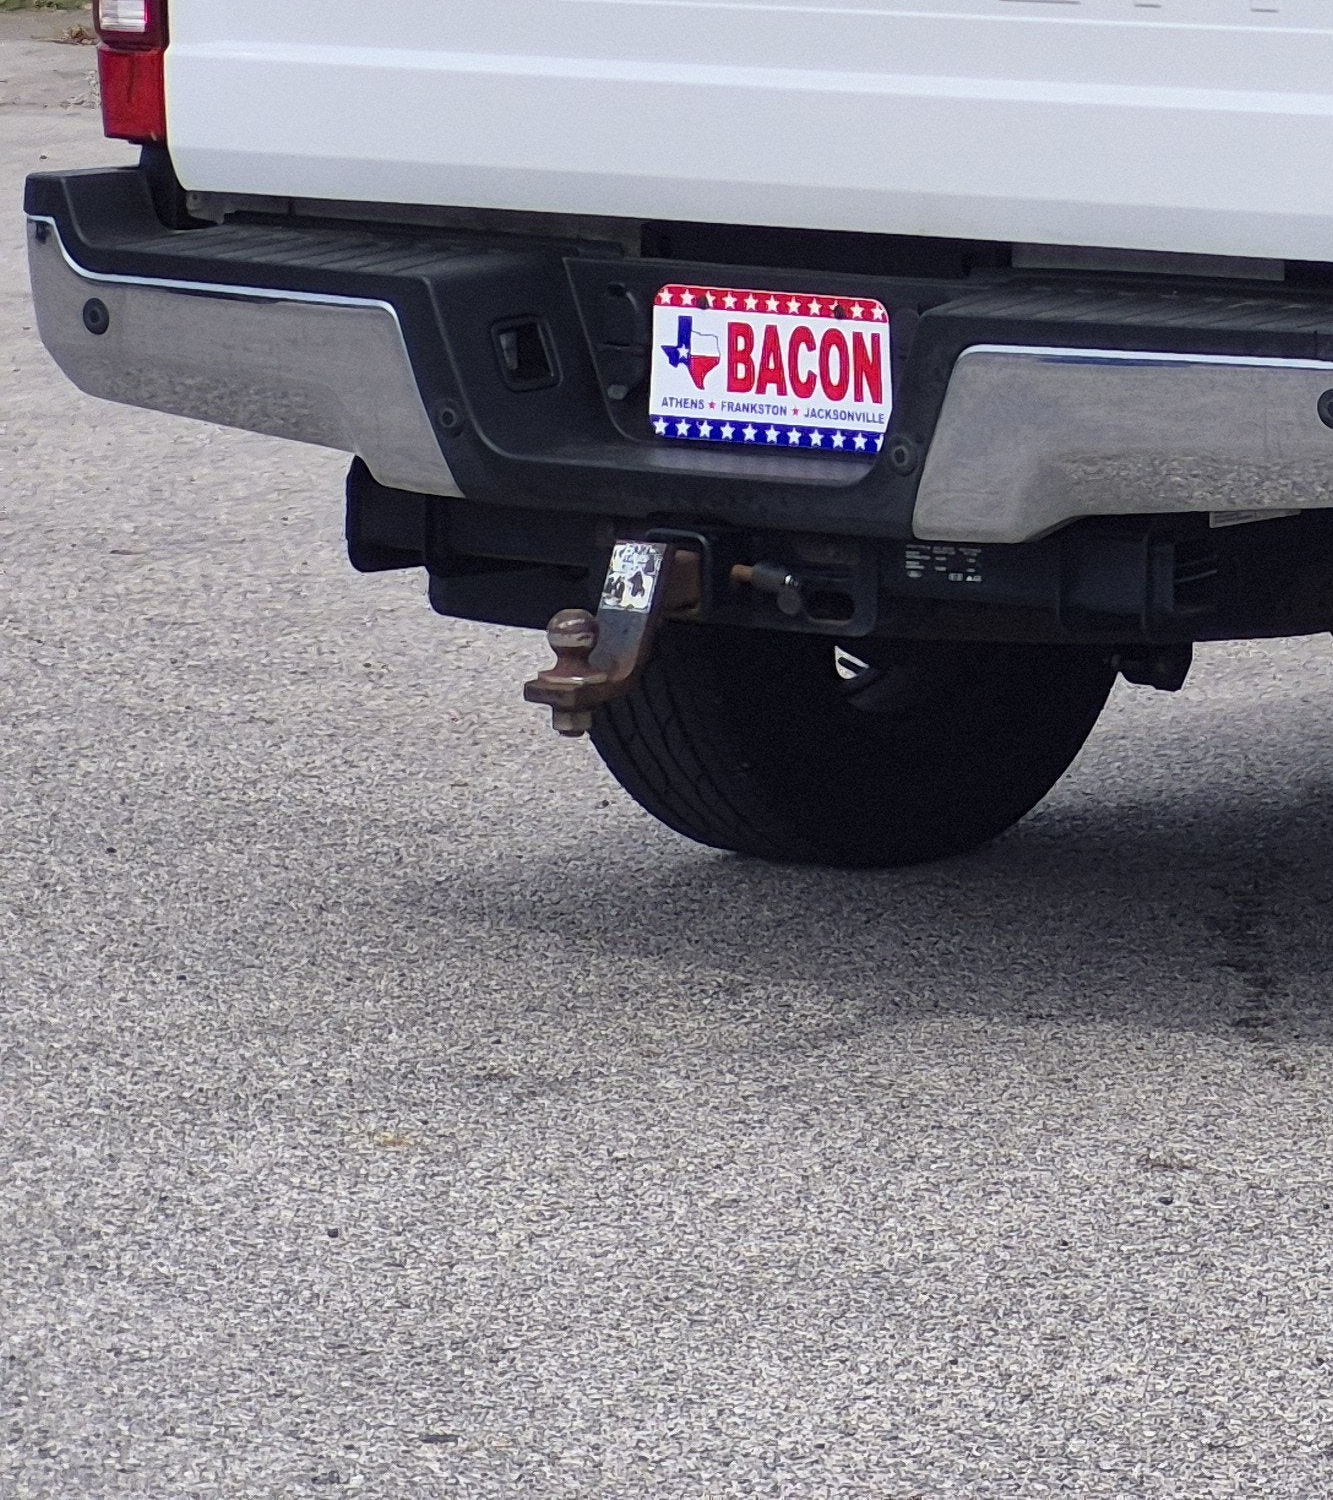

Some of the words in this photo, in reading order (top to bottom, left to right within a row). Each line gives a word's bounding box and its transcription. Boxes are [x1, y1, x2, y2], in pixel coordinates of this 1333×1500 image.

[726, 321, 883, 405] BACON
[661, 396, 705, 410] ATHENS
[720, 400, 788, 417] FRANKSTON
[804, 406, 885, 425] JACKSONVILLE
